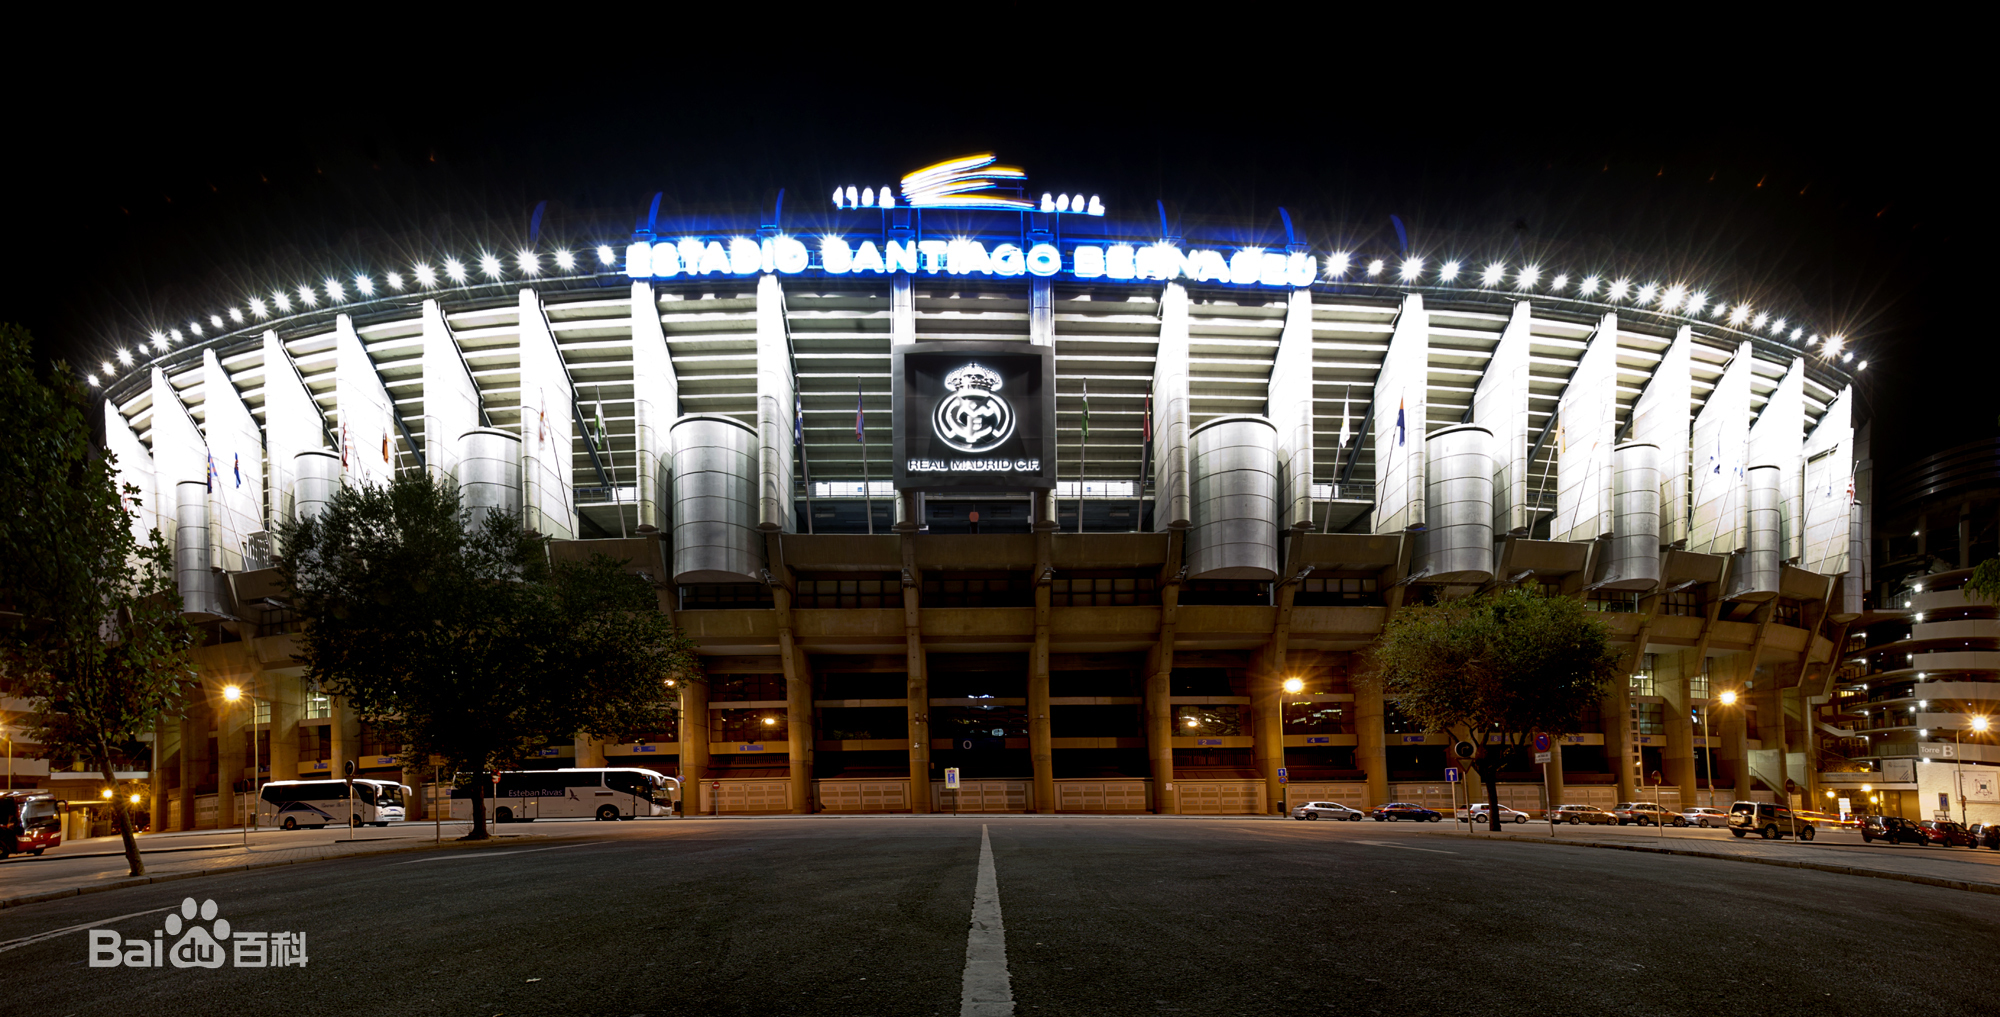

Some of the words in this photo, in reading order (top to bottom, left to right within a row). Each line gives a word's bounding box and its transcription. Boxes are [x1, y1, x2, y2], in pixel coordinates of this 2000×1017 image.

[625, 238, 809, 278] ESTADIO
[821, 240, 1062, 277] SANTIAGO
[908, 458, 948, 471] REAL
[951, 458, 1012, 471] MADRID
[1942, 745, 1954, 757] B
[508, 789, 540, 797] Esteban
[541, 788, 563, 796] Rivas
